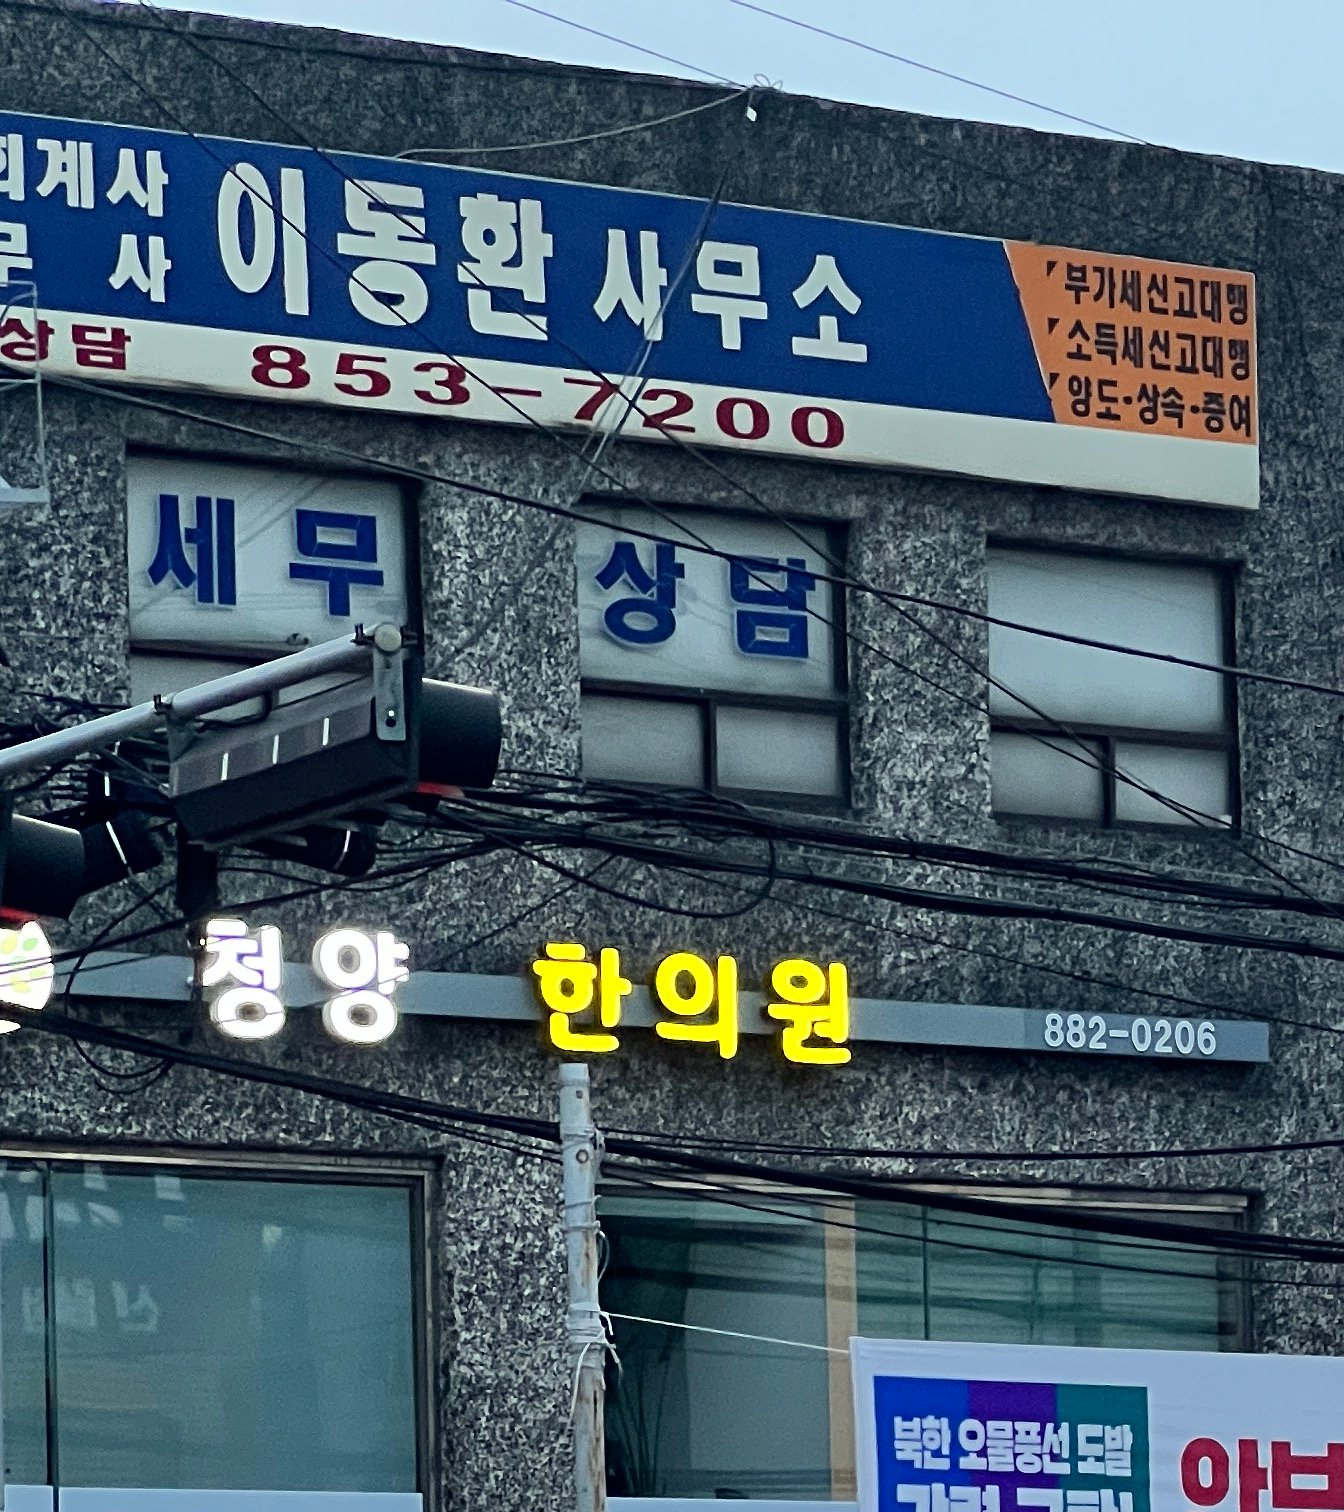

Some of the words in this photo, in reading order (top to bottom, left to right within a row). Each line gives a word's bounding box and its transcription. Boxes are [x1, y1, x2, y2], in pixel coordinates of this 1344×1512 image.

[217, 163, 553, 340] 이동환
[594, 229, 867, 362] 사무소
[1065, 263, 1248, 326] 부가세신고대행
[1066, 319, 1250, 381] 소득세신고대행
[251, 345, 843, 448] 853-7200
[147, 494, 384, 616] 세무
[595, 540, 816, 659] 상담
[203, 918, 410, 1044] 청양
[533, 943, 851, 1065] 한의원
[1044, 1012, 1218, 1056] 882-0206
[894, 1415, 951, 1470] 북한
[958, 1418, 1070, 1475] 오물풍선
[1077, 1424, 1133, 1477] 도발
